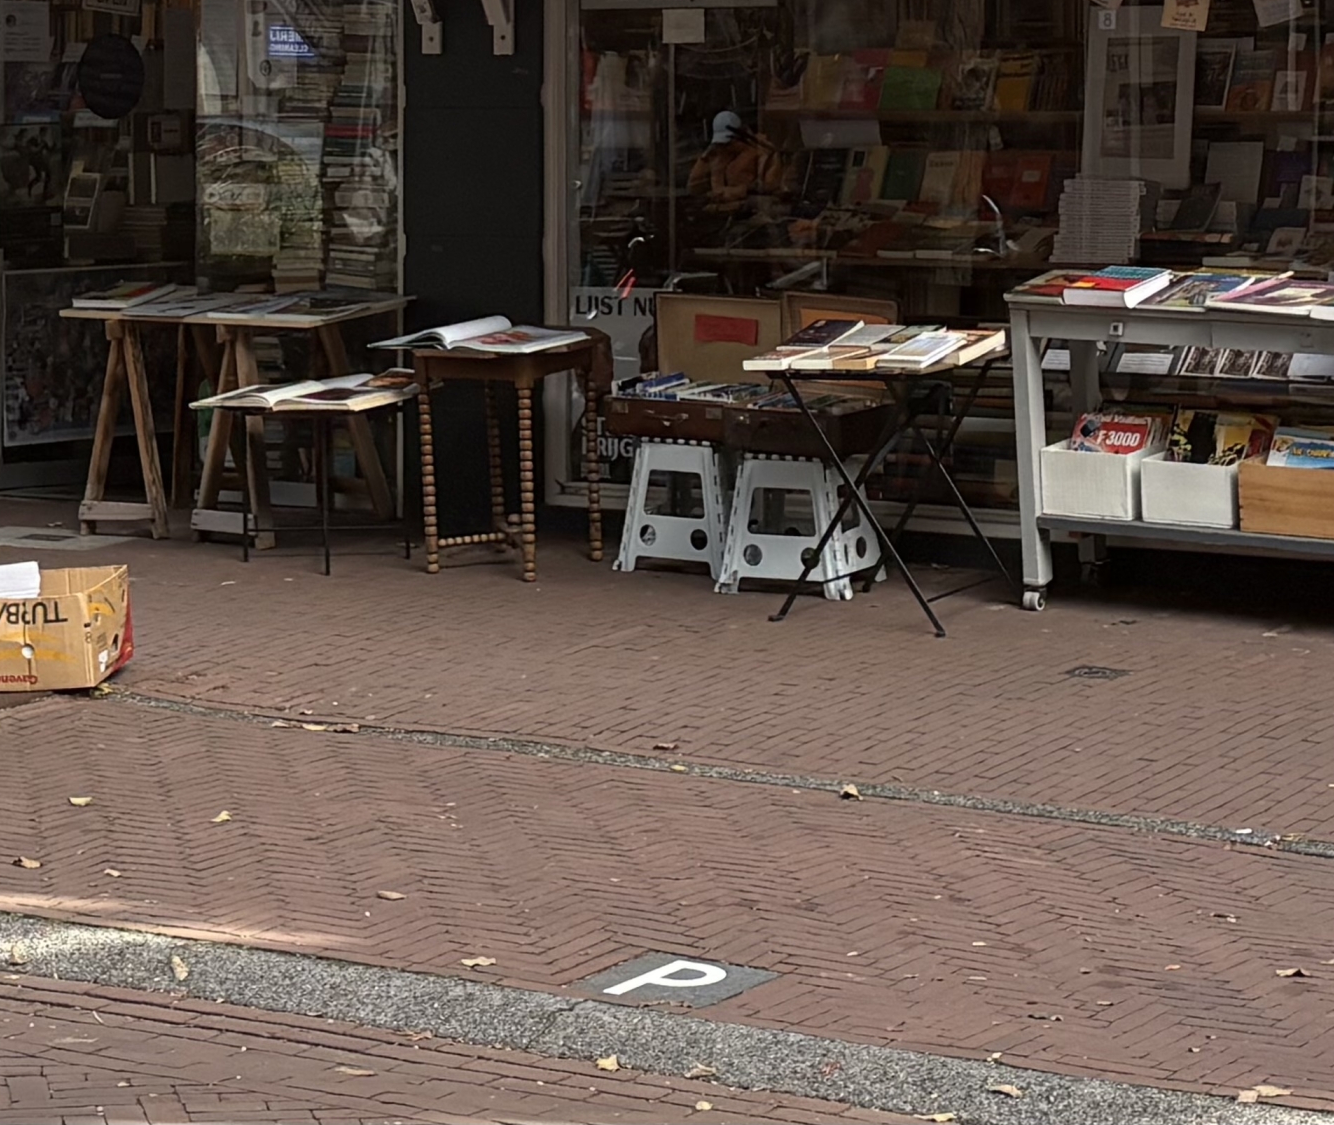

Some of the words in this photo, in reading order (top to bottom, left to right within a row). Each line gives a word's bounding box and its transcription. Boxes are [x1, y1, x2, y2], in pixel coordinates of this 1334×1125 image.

[1096, 430, 1107, 445] F
[1105, 430, 1141, 447] 3000
[602, 959, 727, 996] P
